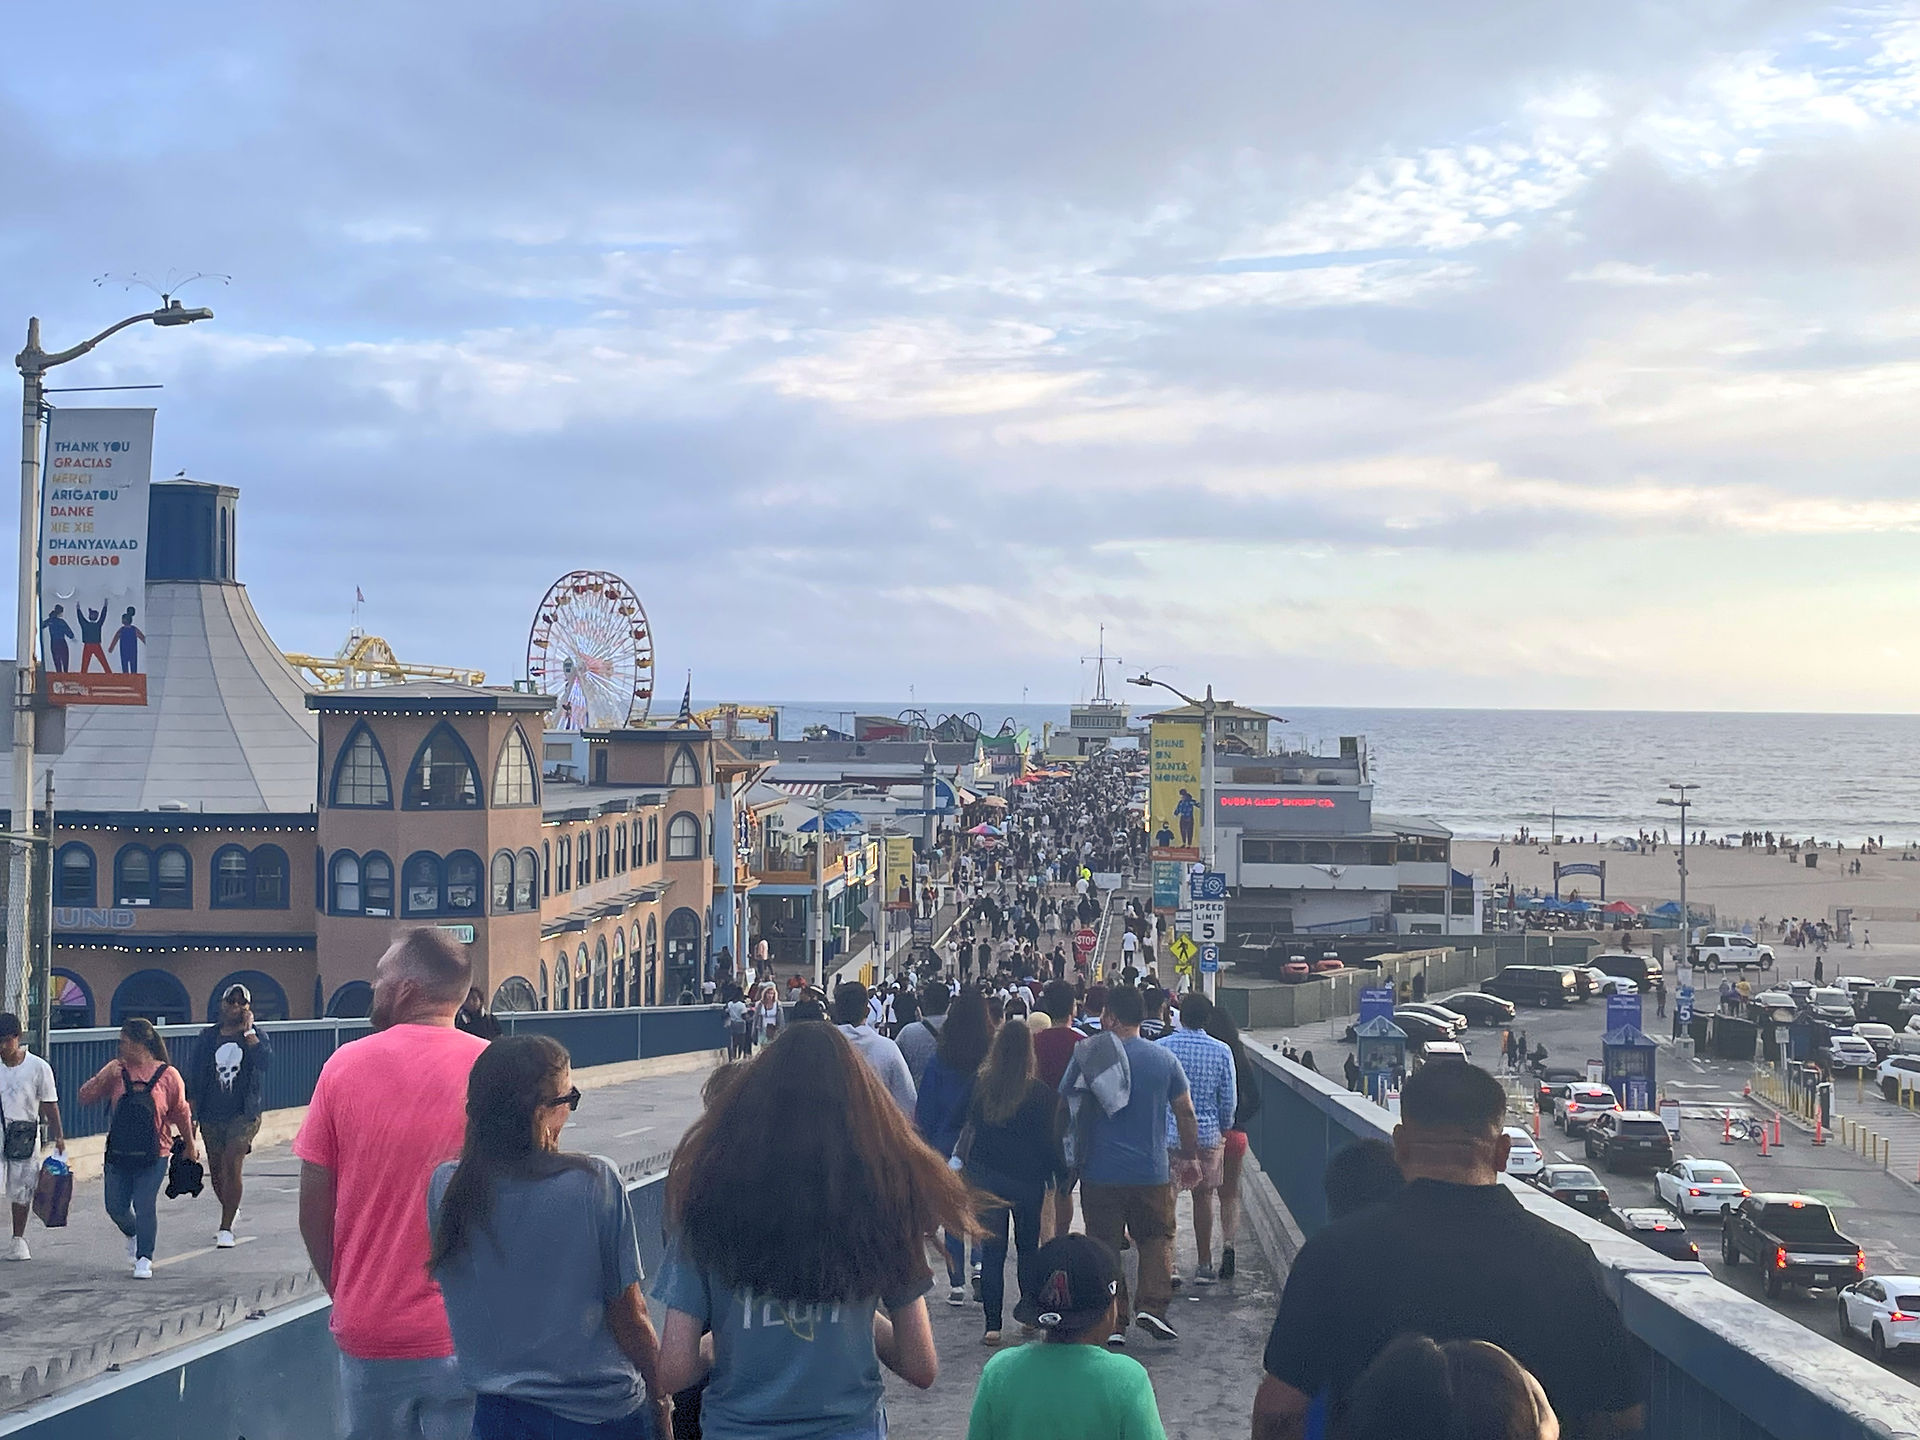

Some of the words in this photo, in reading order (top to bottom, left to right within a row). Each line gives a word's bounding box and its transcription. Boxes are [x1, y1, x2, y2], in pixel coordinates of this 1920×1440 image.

[55, 441, 99, 452] THANK
[103, 441, 130, 452] YOU
[54, 457, 113, 468] GRACIAS
[51, 489, 119, 500] ARIGATOU
[50, 506, 94, 517] DANKE
[49, 539, 139, 550] DHANYAVAAD
[49, 555, 120, 566] OBRIGADO
[1154, 739, 1185, 748] SHINE
[1155, 751, 1172, 759] ON
[1154, 762, 1188, 770] SANTA
[1154, 773, 1197, 783] MONICA
[1193, 903, 1224, 912] SPEED
[1196, 913, 1221, 921] LIMIT
[1202, 922, 1215, 940] 5
[1076, 935, 1097, 945] STOP
[1679, 1005, 1691, 1020] 5
